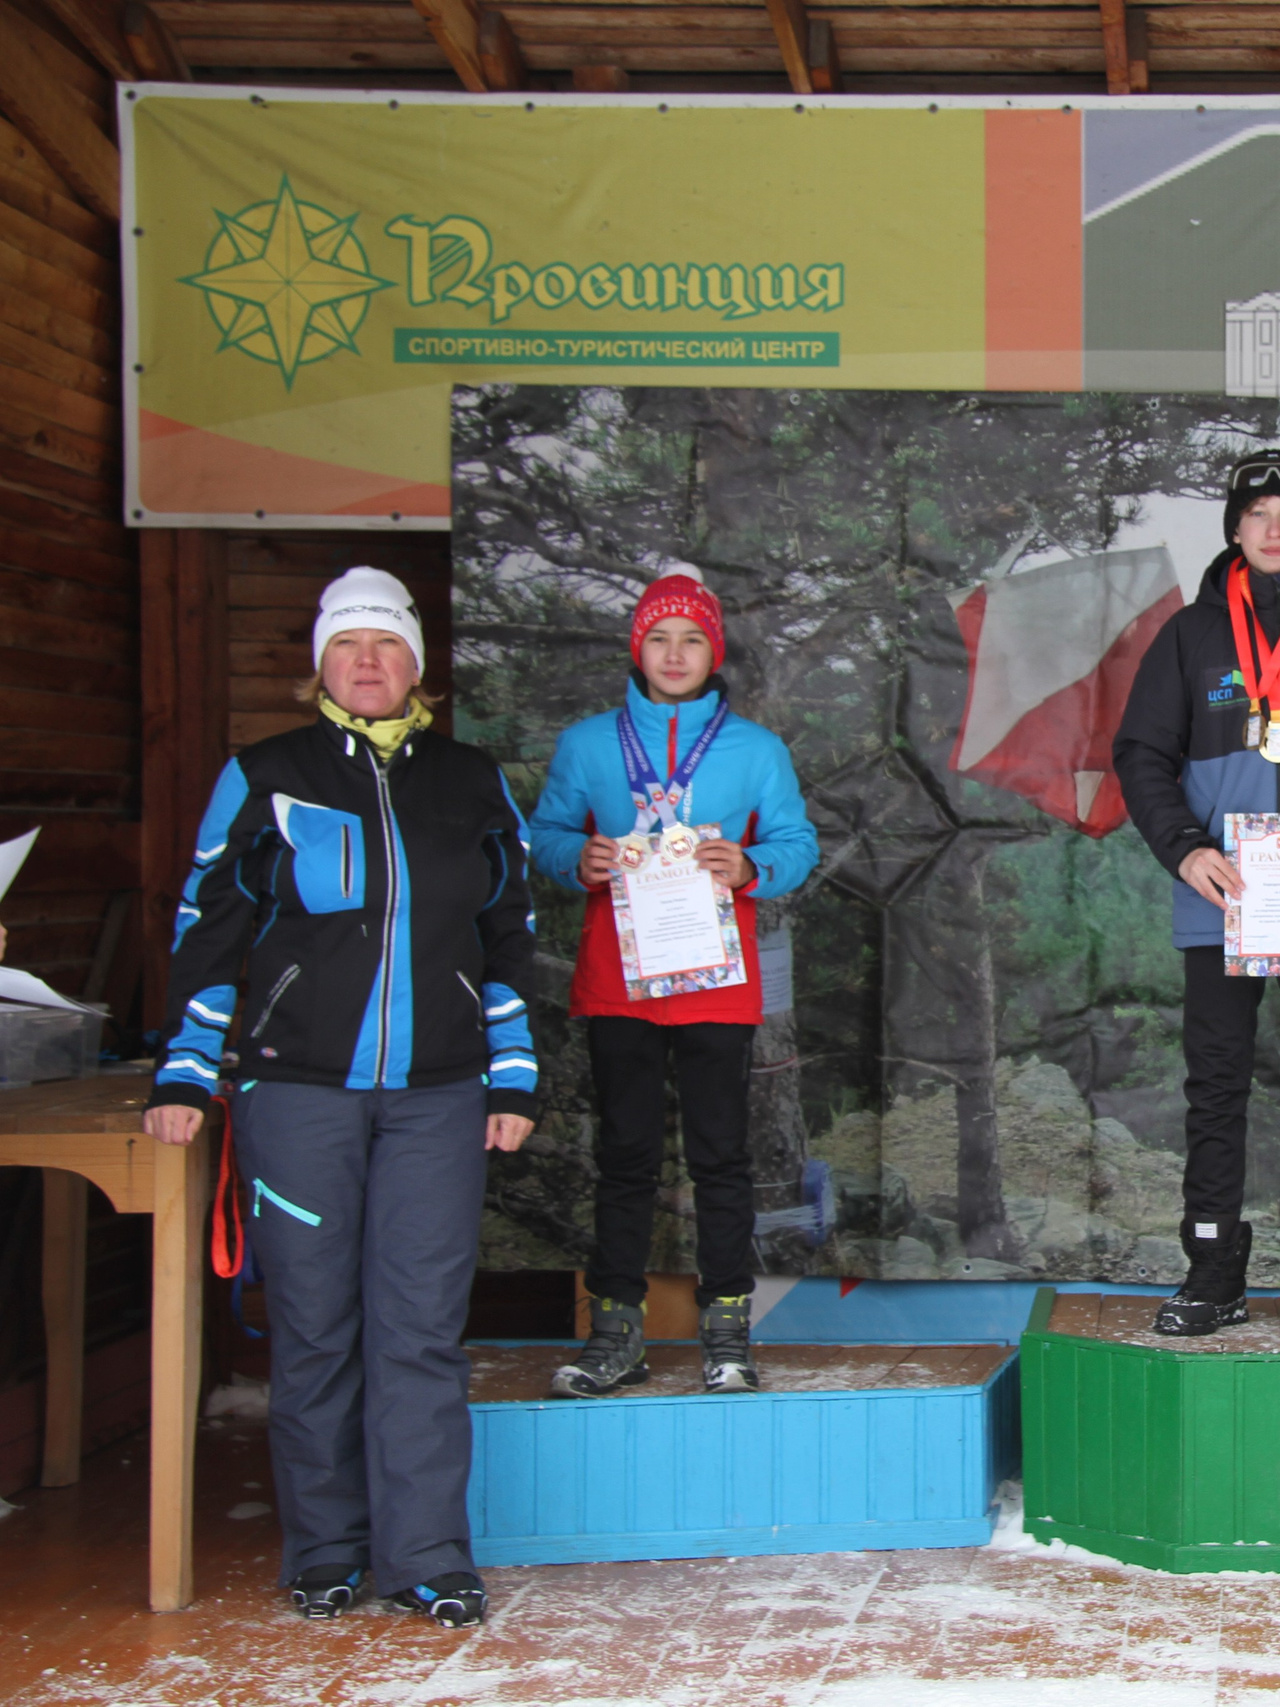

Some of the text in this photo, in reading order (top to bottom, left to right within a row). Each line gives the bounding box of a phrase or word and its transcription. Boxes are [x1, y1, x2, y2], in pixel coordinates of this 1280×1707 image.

[384, 214, 844, 325] Провинция
[408, 336, 825, 361] СПОРТИВНО-ТУРИСТИЧЕСКИЙ ЦЕНТР
